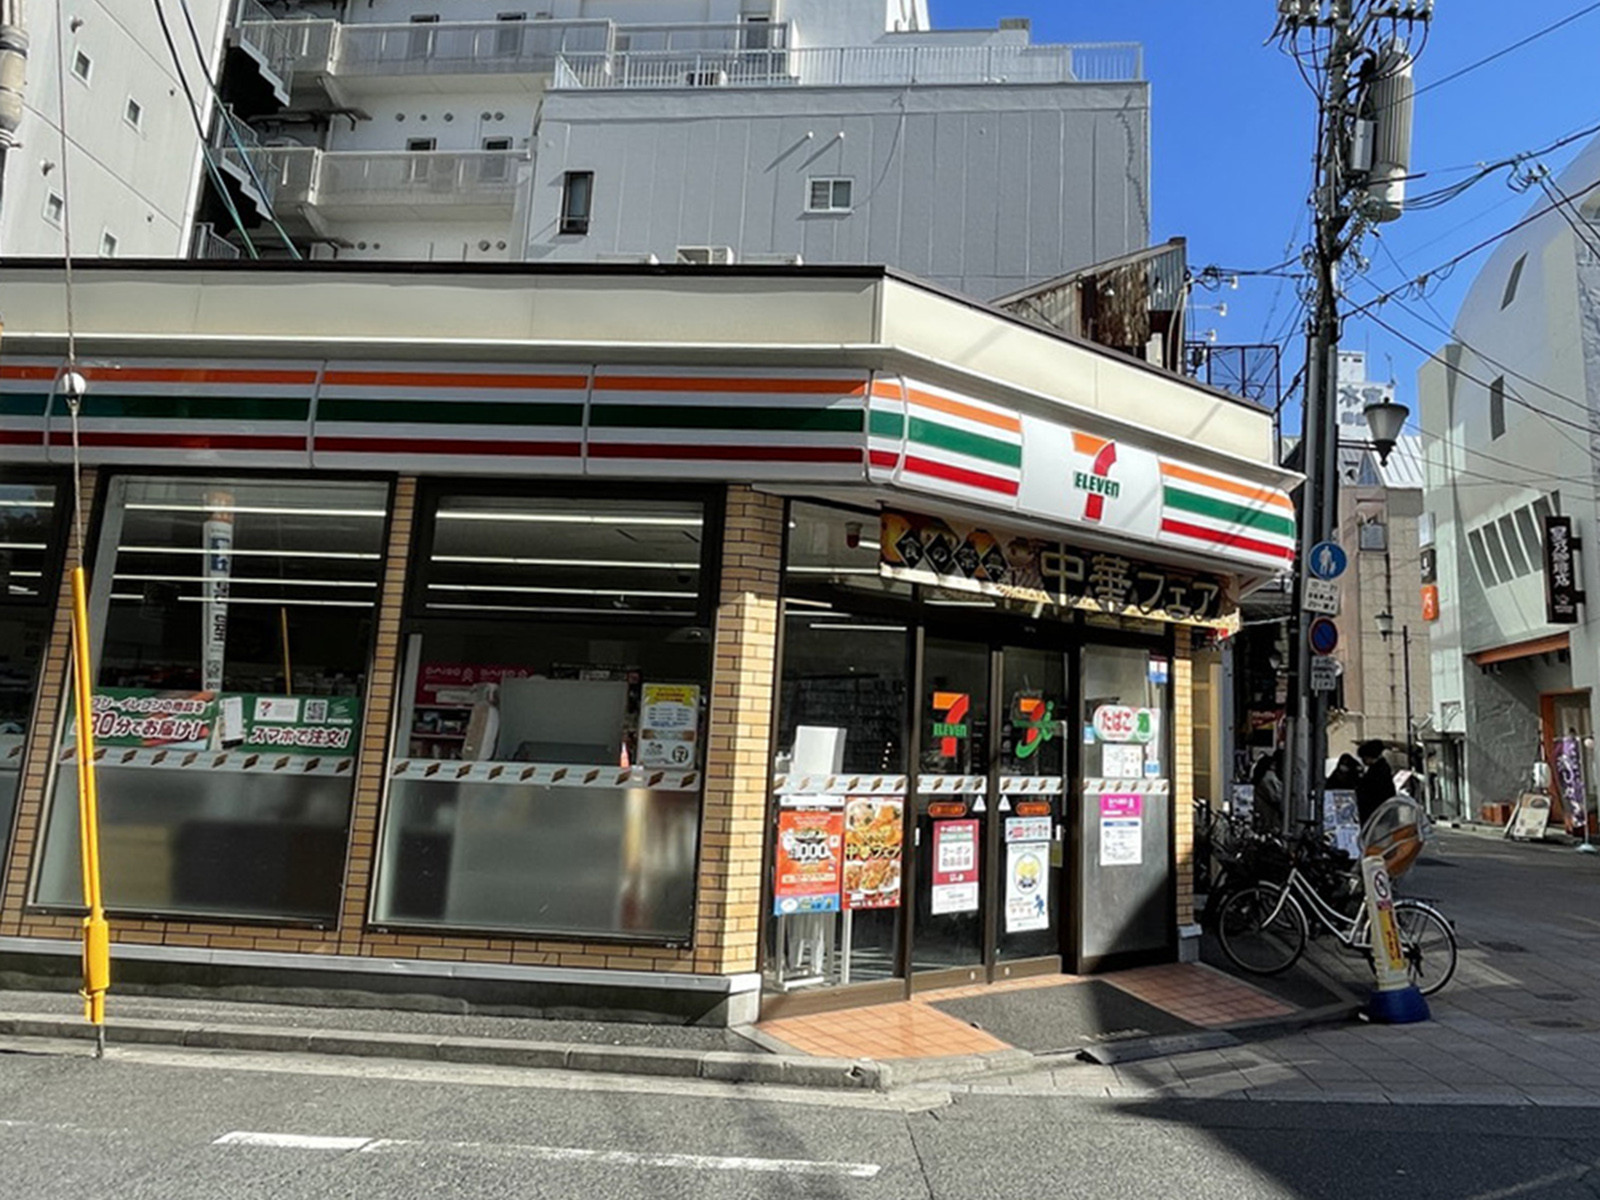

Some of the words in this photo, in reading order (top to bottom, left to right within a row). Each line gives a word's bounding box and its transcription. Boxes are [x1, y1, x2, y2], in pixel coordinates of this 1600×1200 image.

[1040, 542, 1219, 621] 中華フェア
[249, 726, 352, 748] スマホで注文!
